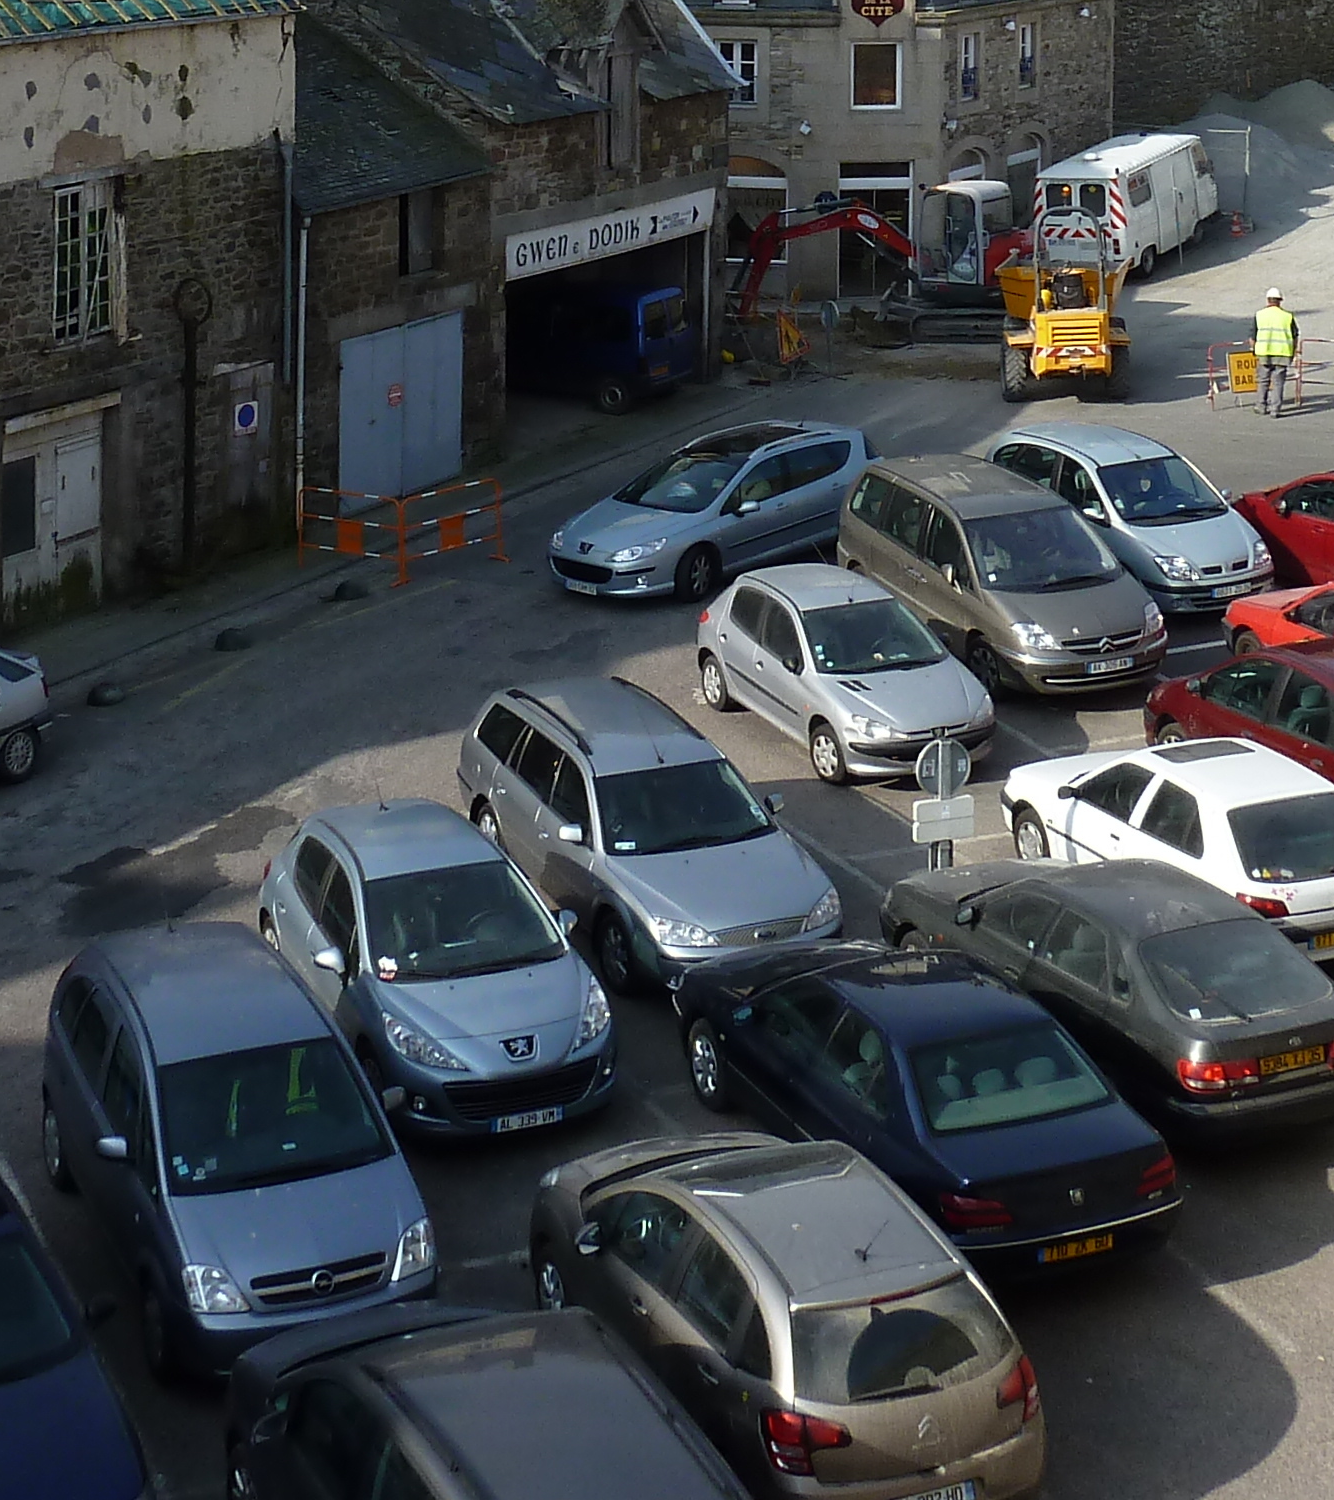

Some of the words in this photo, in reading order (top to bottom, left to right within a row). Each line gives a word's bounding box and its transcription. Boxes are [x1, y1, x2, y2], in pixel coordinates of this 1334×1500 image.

[861, 6, 894, 16] CITE
[516, 234, 568, 267] GWEN
[589, 217, 640, 250] DODIK
